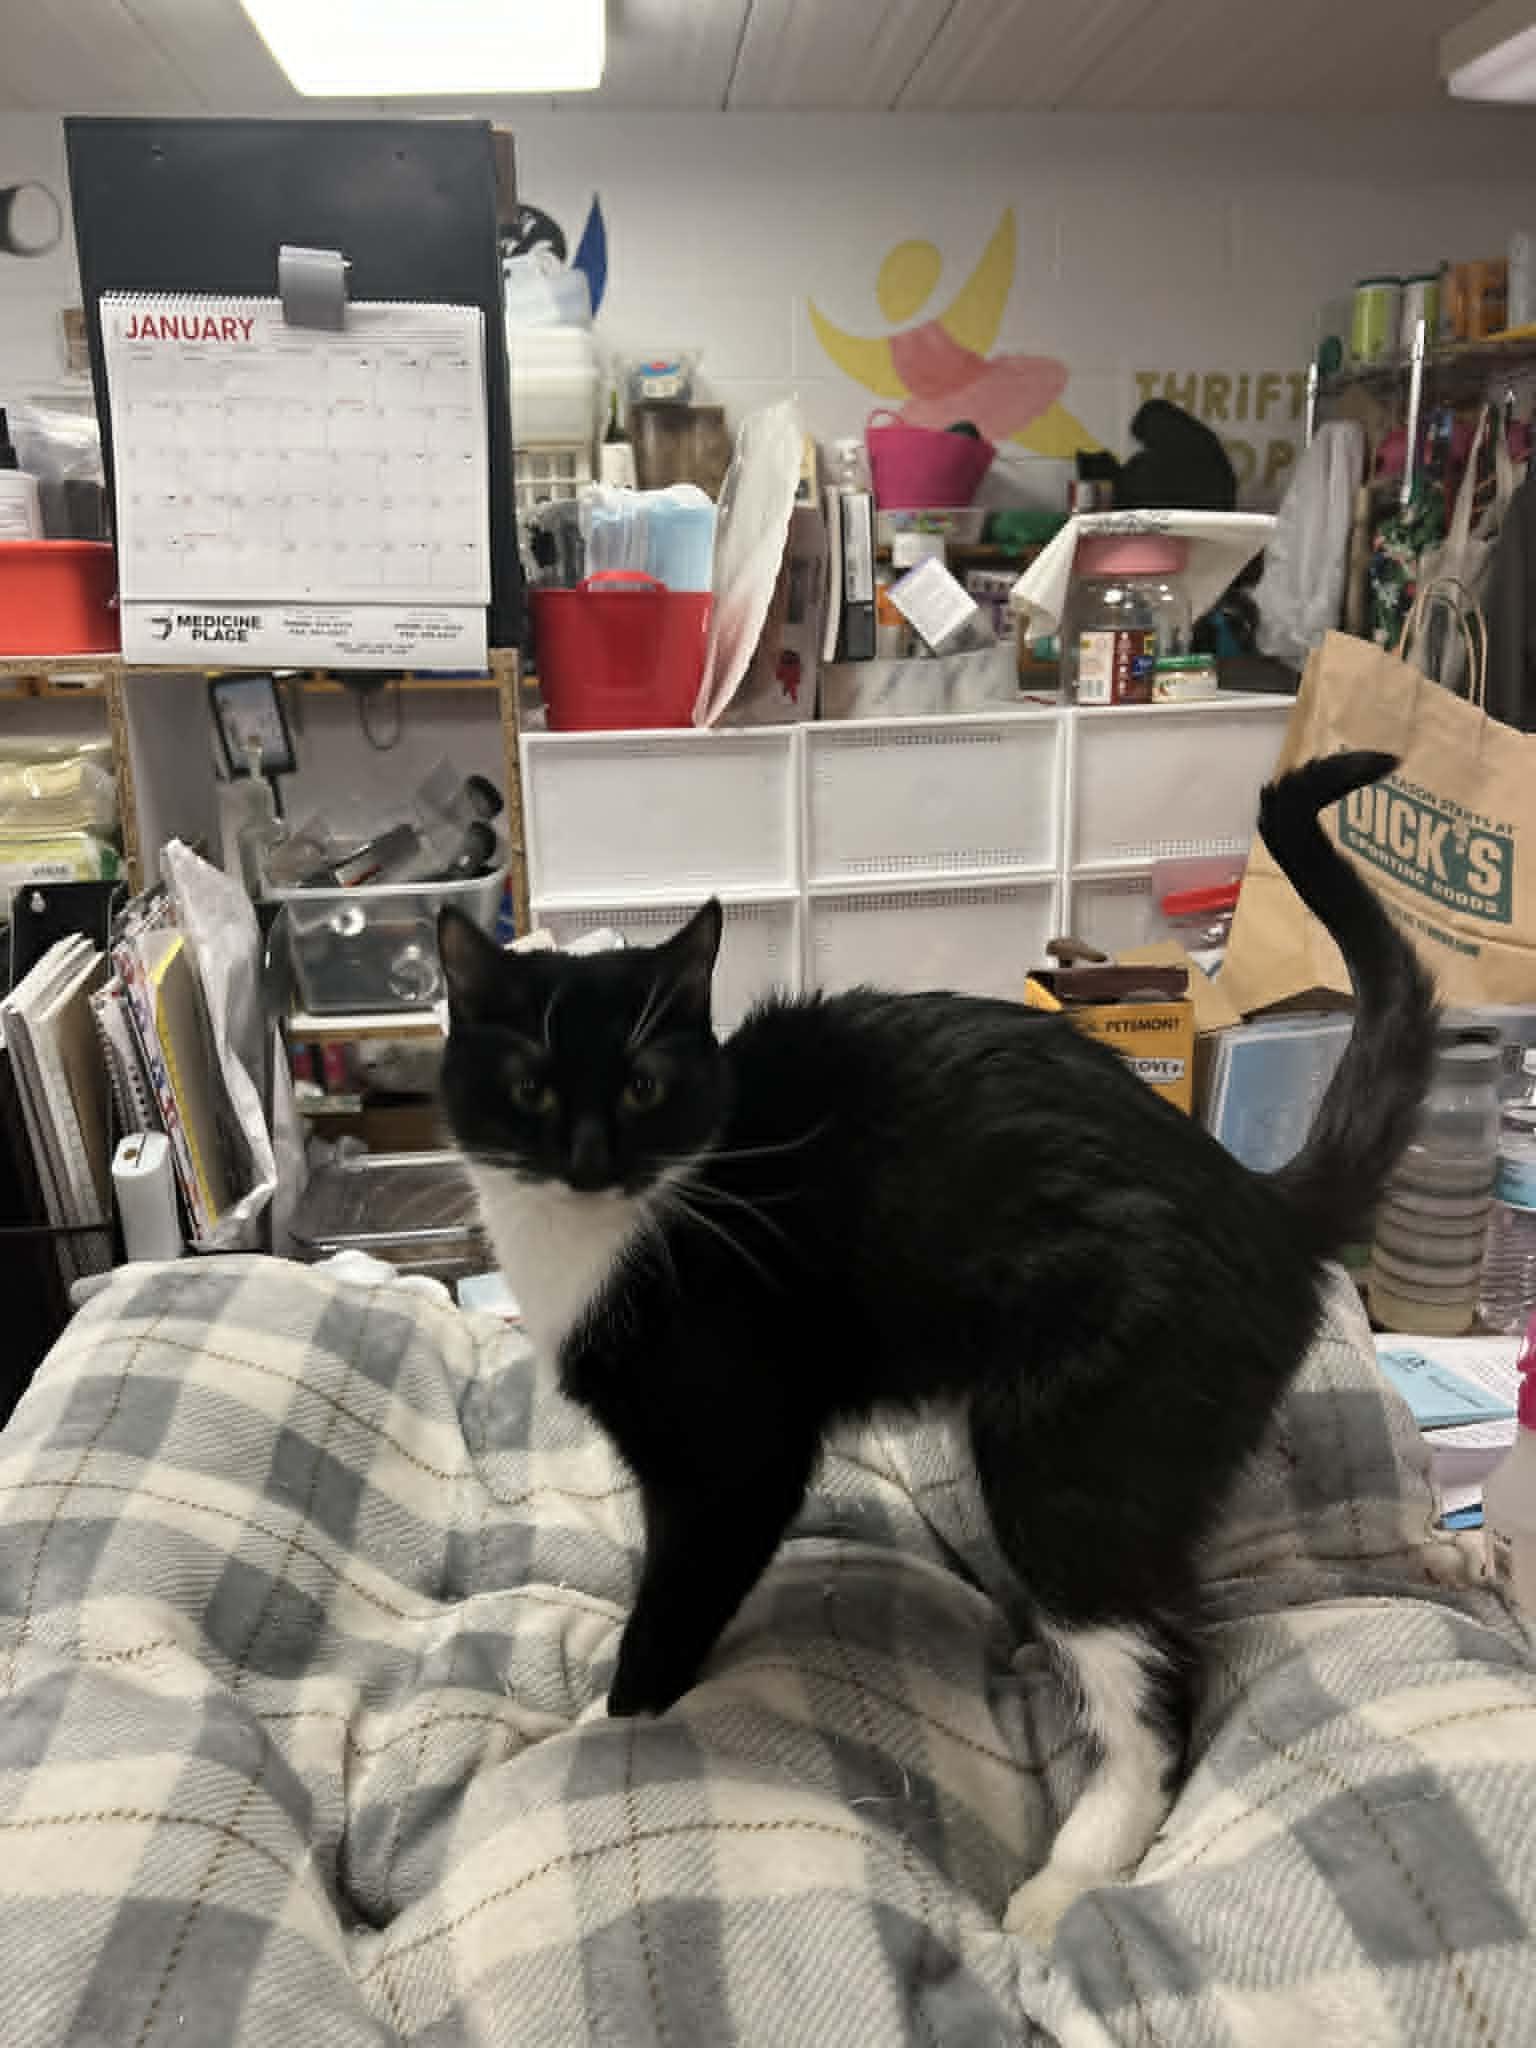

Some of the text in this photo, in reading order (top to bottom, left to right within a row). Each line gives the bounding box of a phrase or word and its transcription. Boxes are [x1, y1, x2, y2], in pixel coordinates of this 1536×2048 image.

[125, 314, 255, 342] JANUARY
[176, 615, 262, 630] MEDICINE
[191, 629, 249, 643] PLACE
[1347, 785, 1504, 897] DICK'S
[1432, 879, 1498, 914] GOODS
